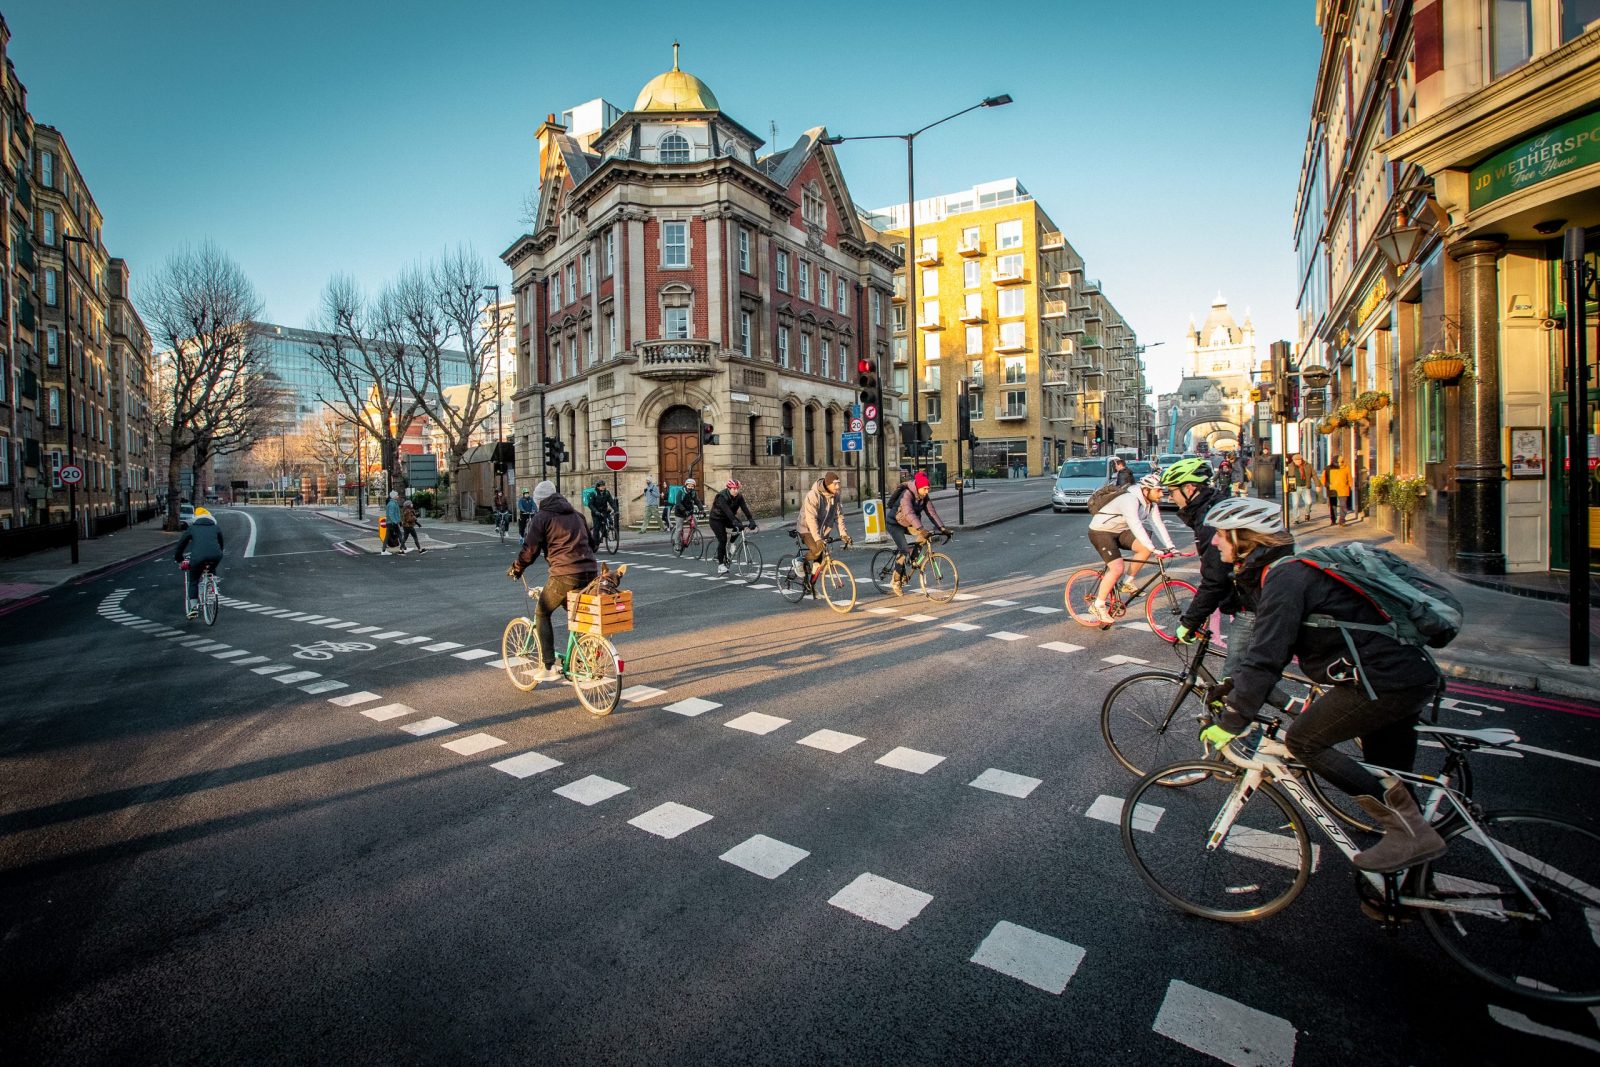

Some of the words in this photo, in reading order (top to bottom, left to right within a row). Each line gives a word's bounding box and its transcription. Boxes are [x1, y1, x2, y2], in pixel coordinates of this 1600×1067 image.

[1475, 174, 1491, 190] JD
[1511, 168, 1535, 187] Free
[1539, 156, 1577, 176] House
[63, 470, 80, 479] 20
[1281, 779, 1357, 850] FELT
